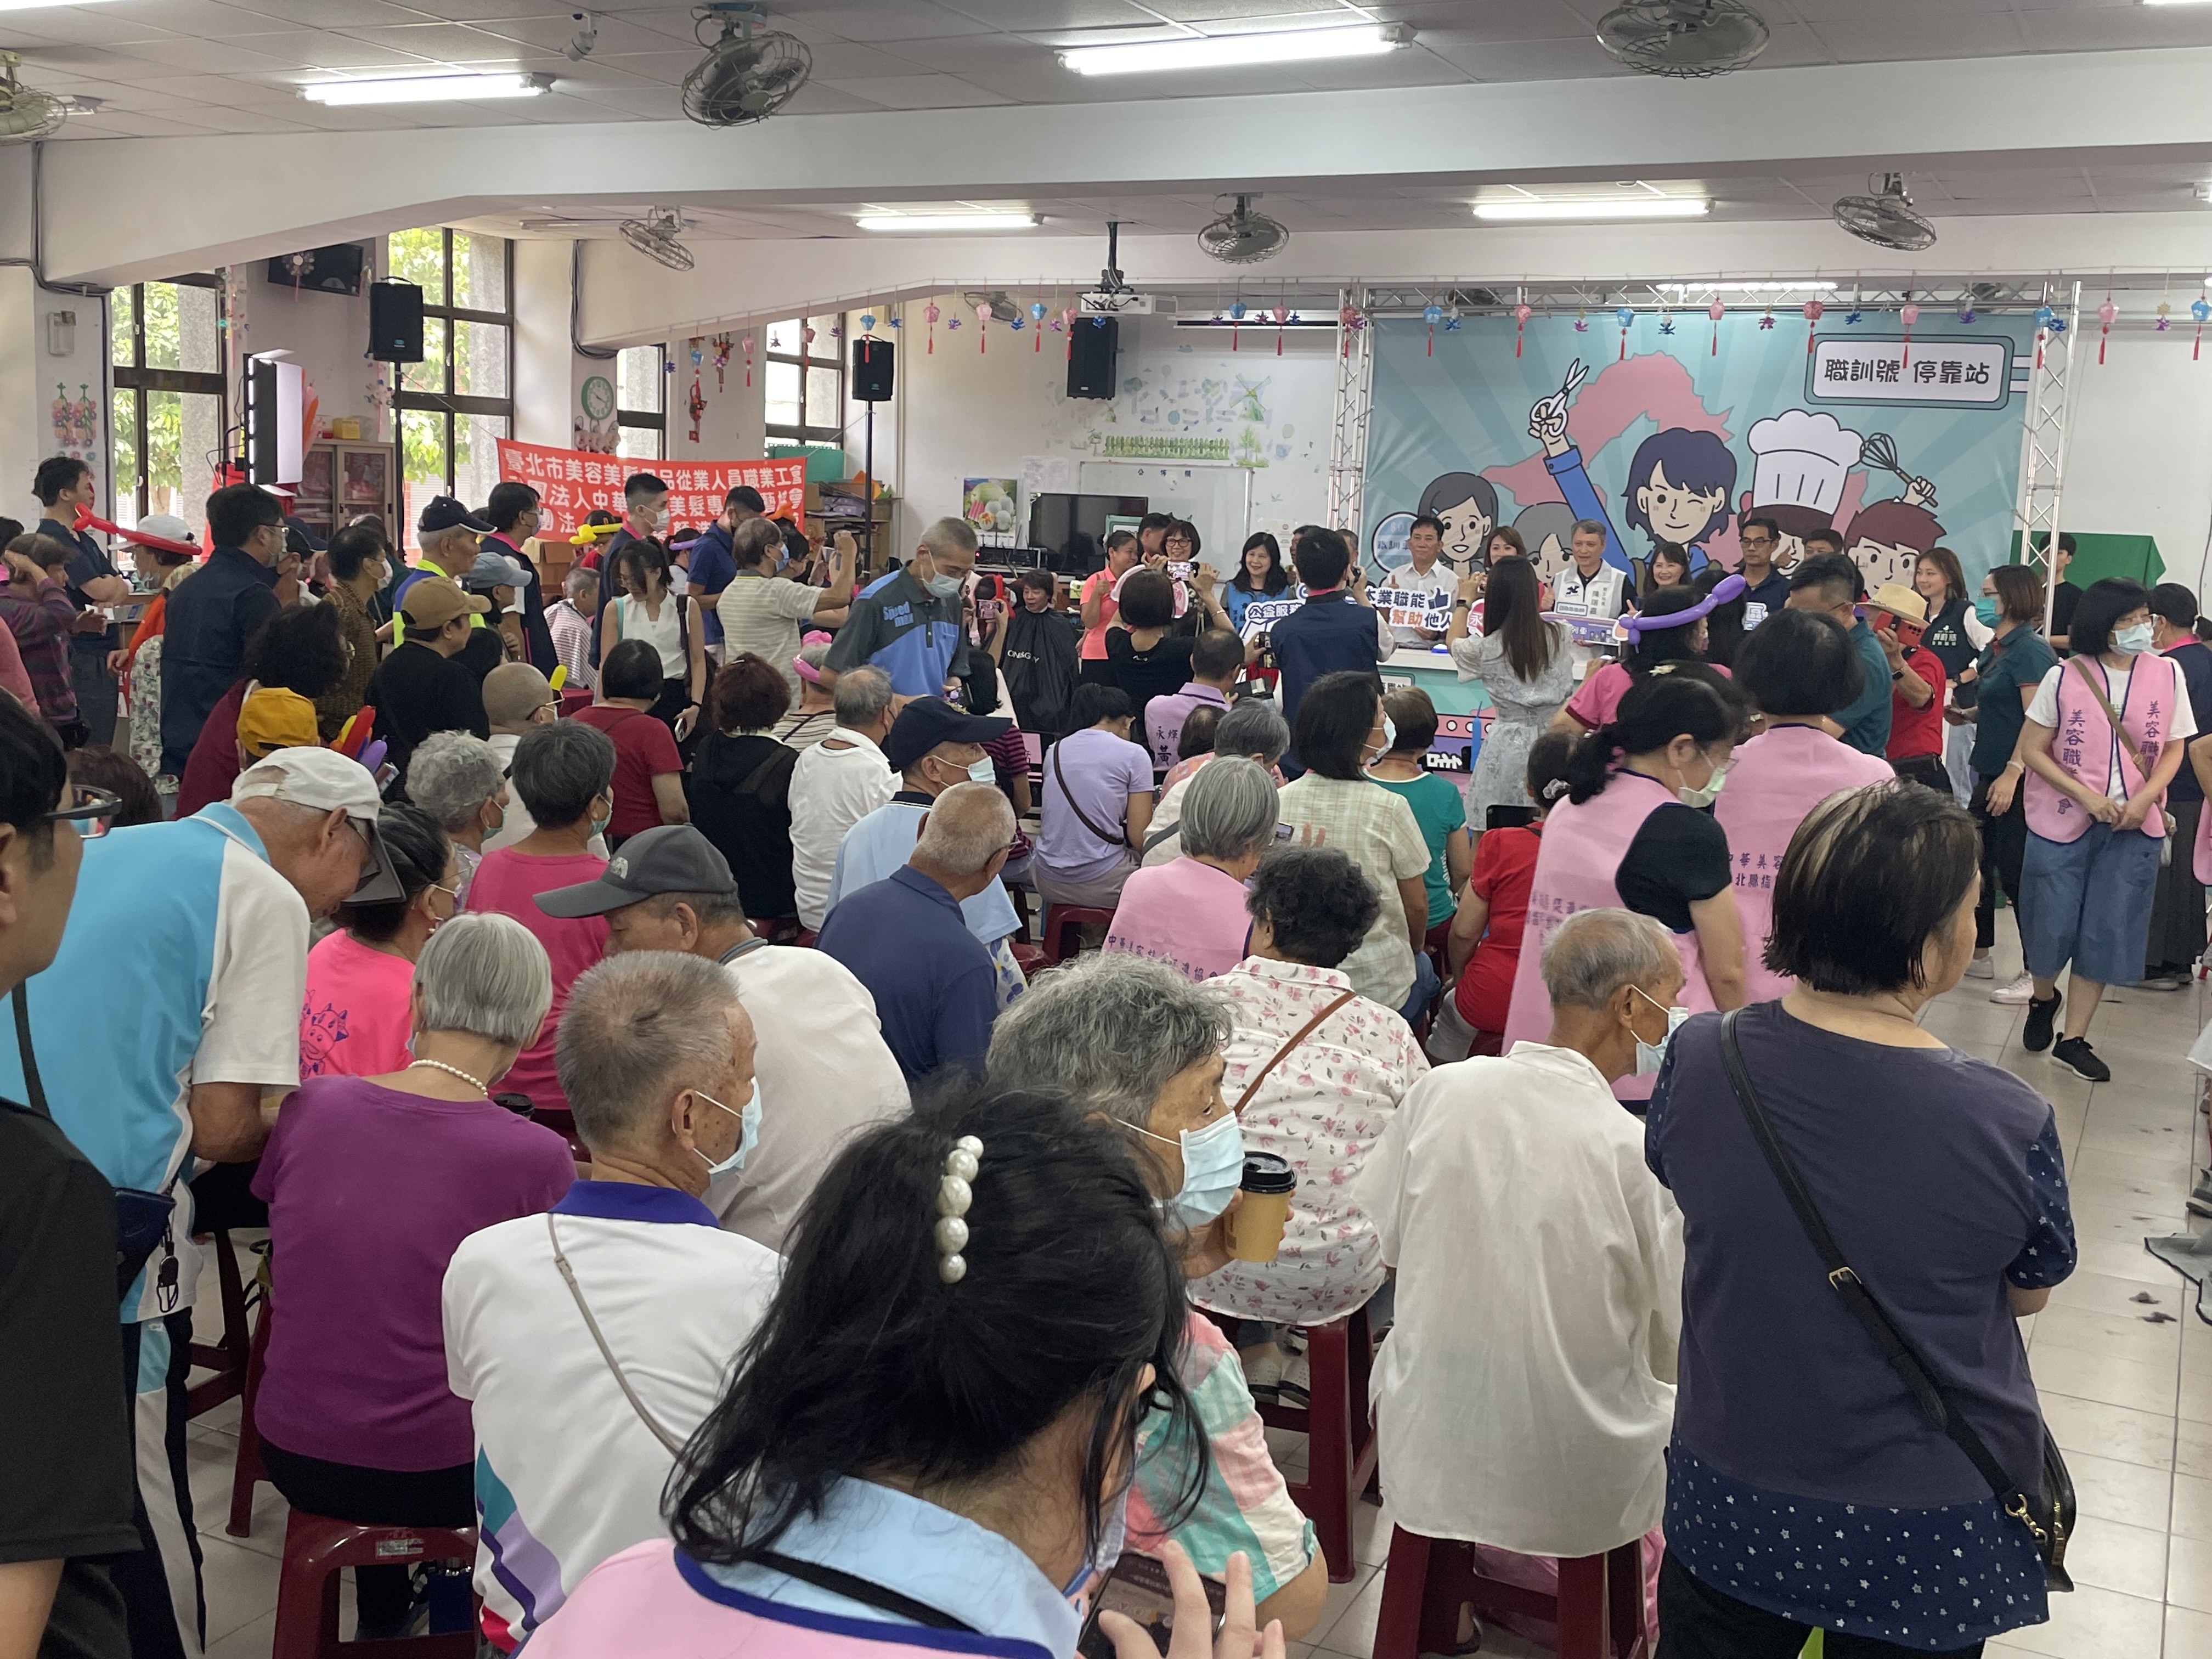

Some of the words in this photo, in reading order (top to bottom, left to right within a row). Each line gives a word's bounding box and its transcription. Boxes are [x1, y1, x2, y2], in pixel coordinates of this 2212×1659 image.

[1824, 358, 1900, 383] 職訓號
[1913, 360, 1990, 385] 停靠站
[1392, 609, 1453, 629] 幫助他人
